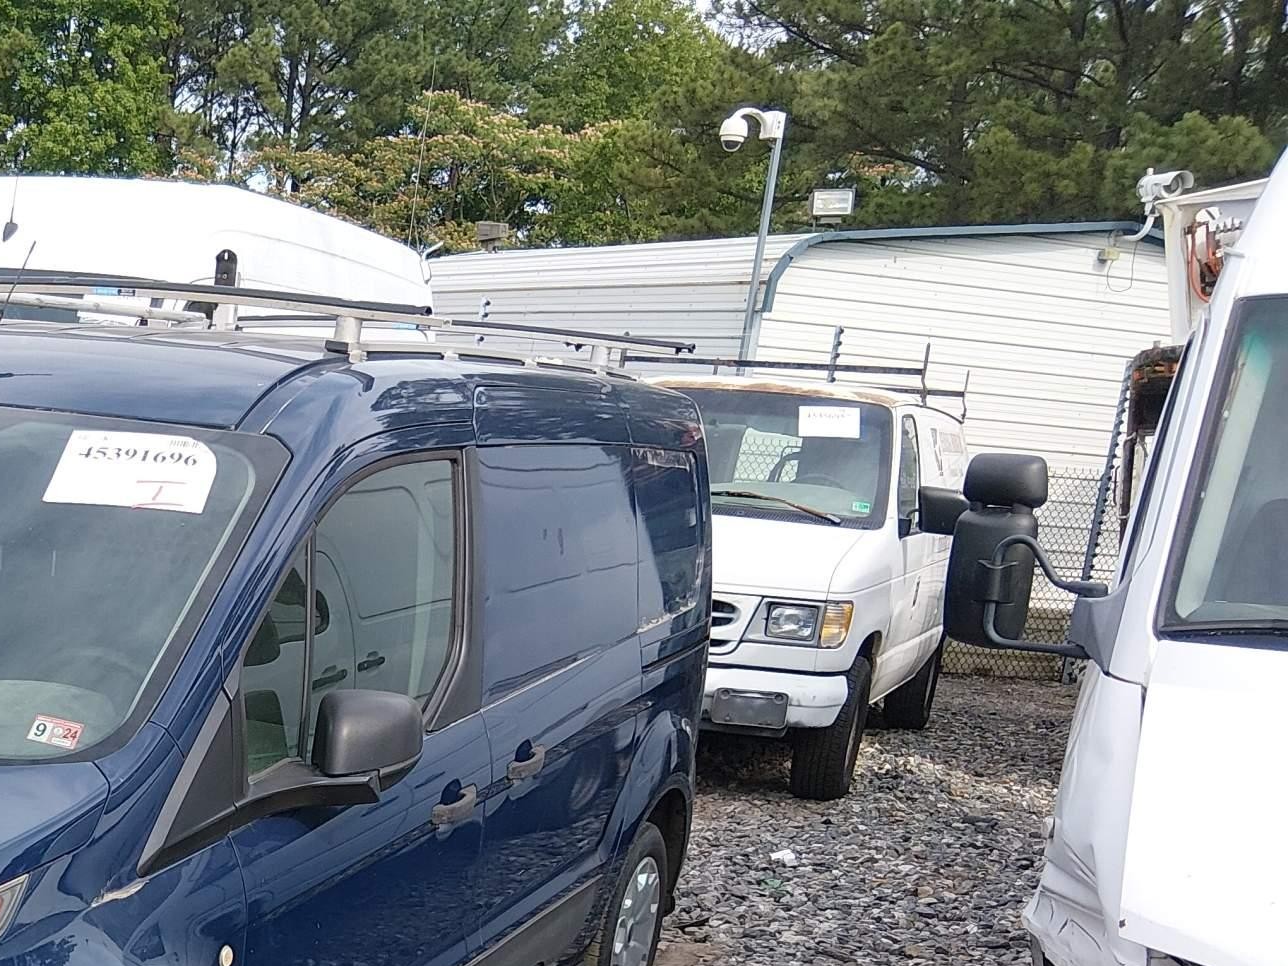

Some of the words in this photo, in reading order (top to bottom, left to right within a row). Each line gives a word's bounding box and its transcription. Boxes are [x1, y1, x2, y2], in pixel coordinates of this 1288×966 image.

[79, 446, 197, 466] 45391696
[34, 722, 47, 738] 9
[62, 728, 78, 740] 24
